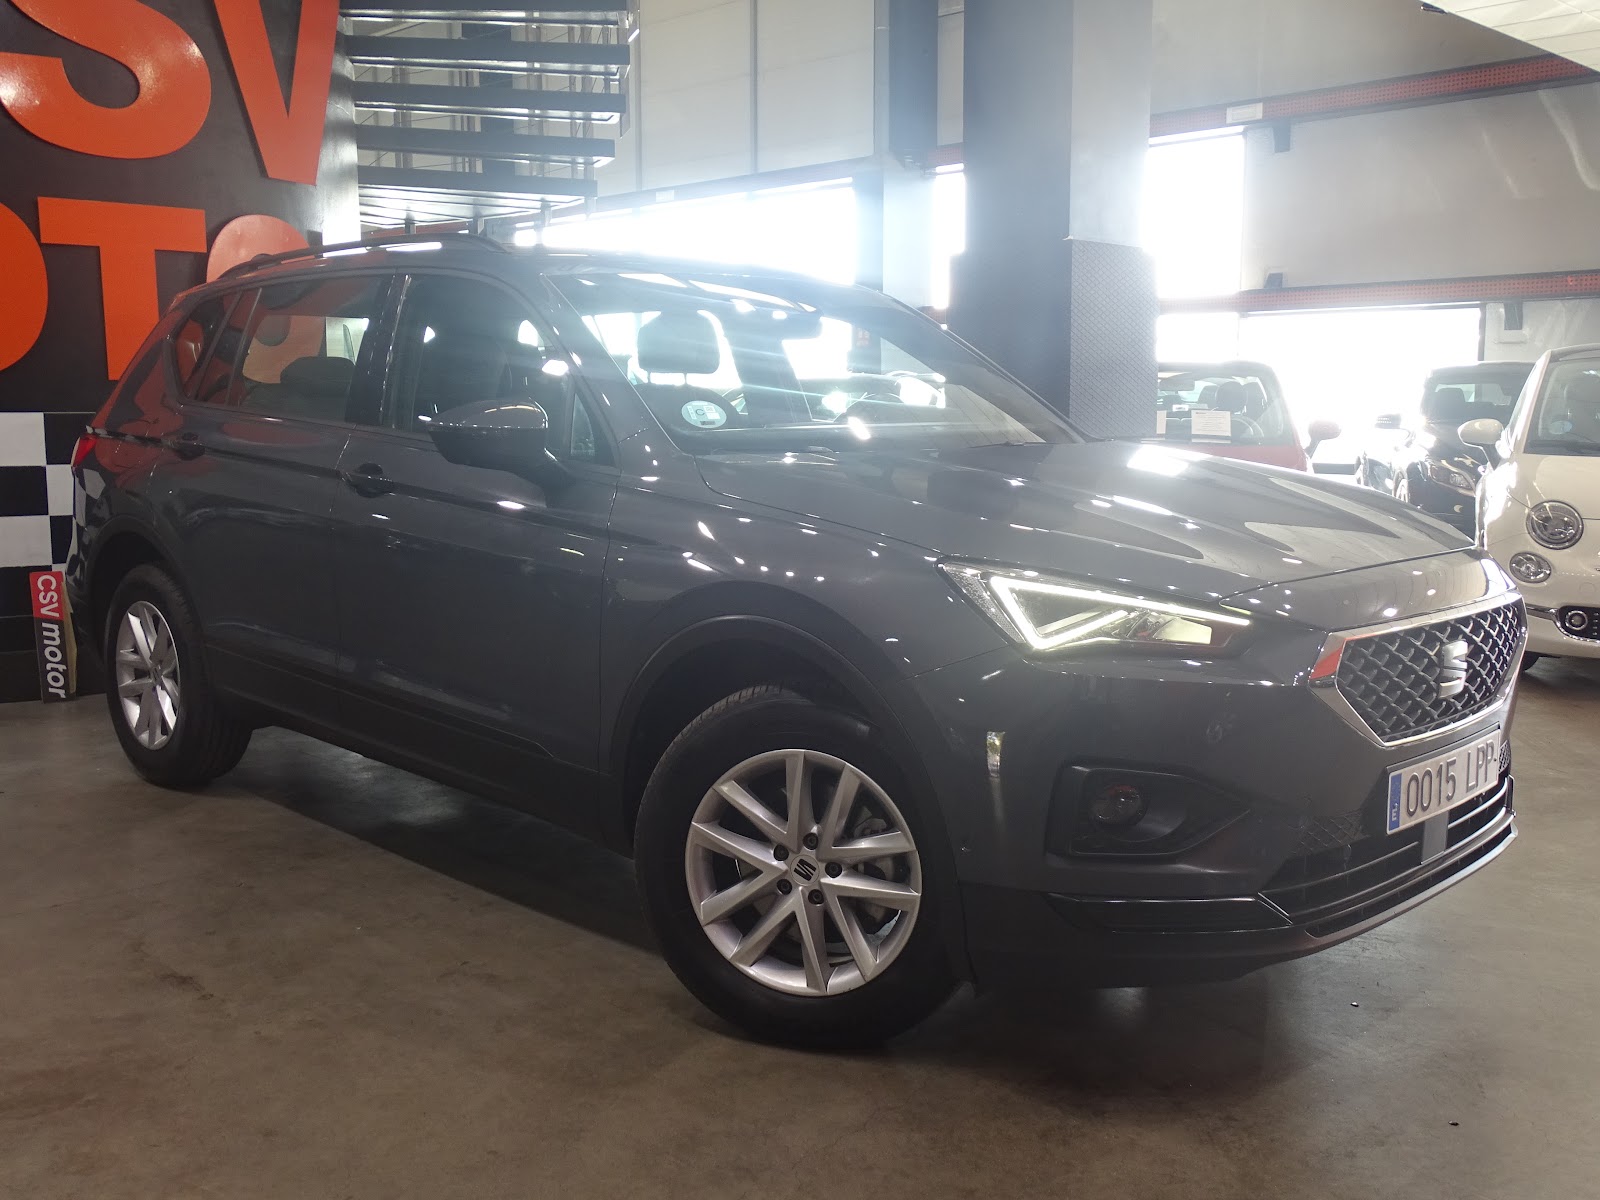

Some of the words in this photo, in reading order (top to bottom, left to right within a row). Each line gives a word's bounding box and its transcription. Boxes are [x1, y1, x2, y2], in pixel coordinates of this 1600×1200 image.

[37, 574, 60, 618] CSV
[42, 622, 67, 699] motor
[1406, 757, 1457, 817] 0015
[1466, 739, 1495, 794] LPP
